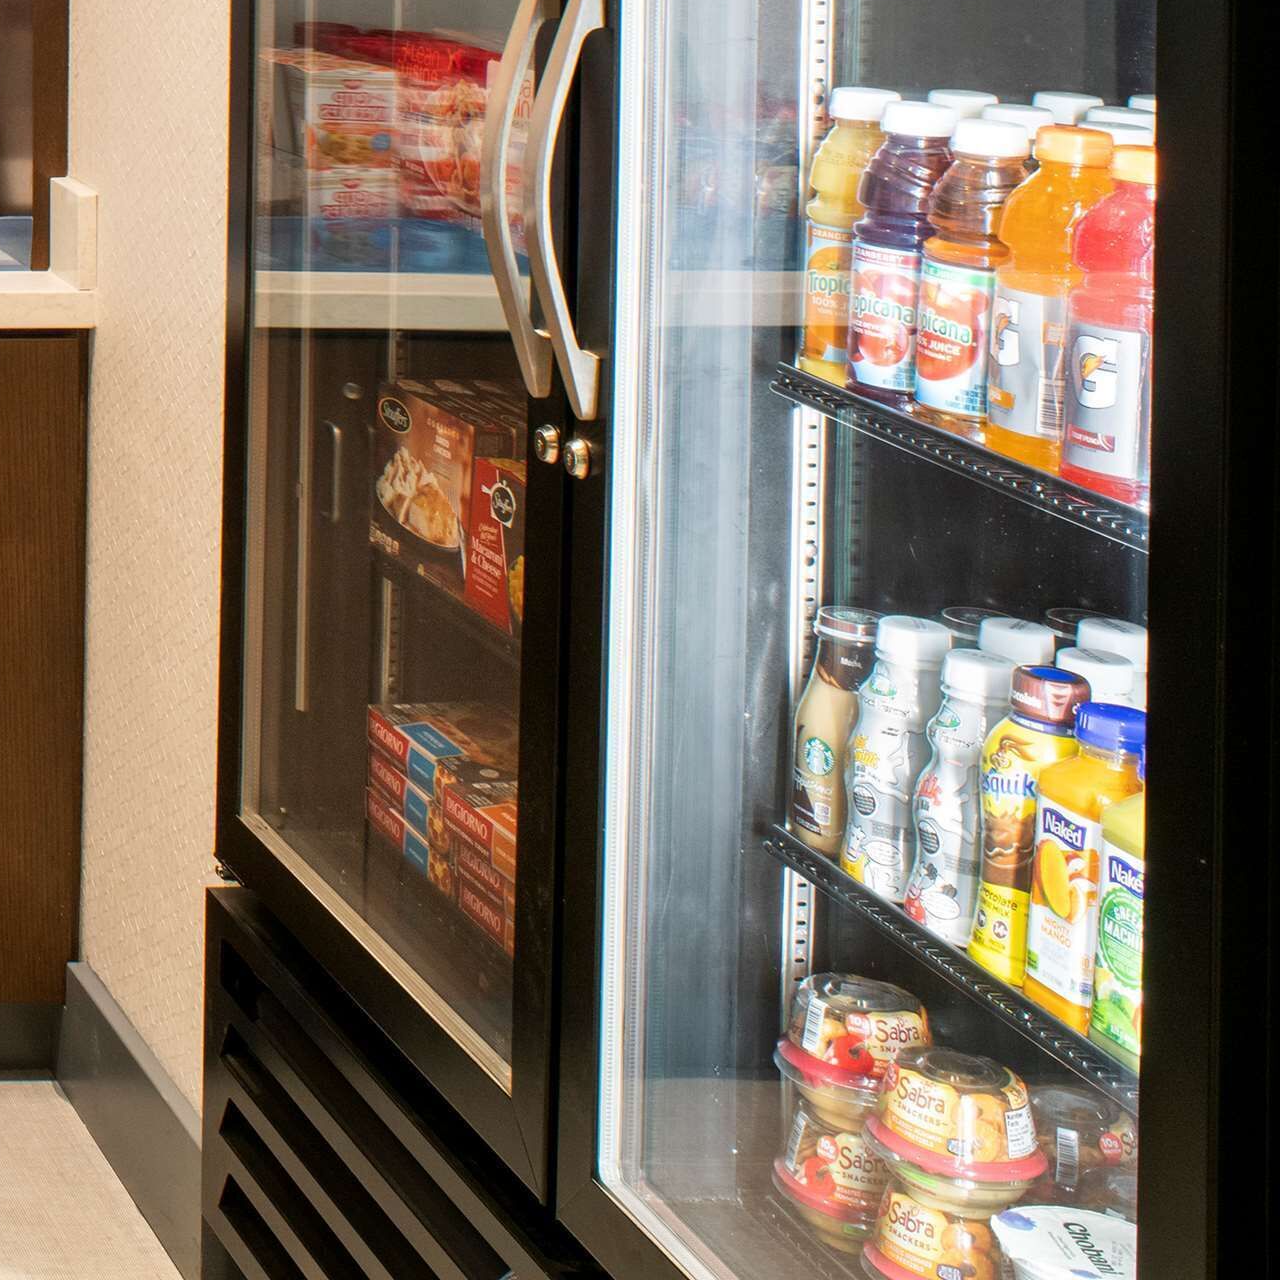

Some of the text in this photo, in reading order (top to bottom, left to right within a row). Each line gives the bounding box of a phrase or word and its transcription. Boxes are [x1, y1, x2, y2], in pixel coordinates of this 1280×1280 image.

[930, 340, 961, 356] JUICE
[471, 536, 503, 566] Macaroni
[478, 553, 503, 578] Cheese
[445, 798, 488, 839] DIGIORNO
[1044, 813, 1084, 849] Naked
[1042, 926, 1072, 949] MANGO
[875, 1019, 921, 1044] Sabra
[896, 1076, 945, 1114] Sabra
[899, 1101, 941, 1127] SNACKERS
[840, 1147, 890, 1174] Sabra
[889, 1202, 935, 1238] Sabra
[889, 1223, 932, 1251] SNACKERS
[1062, 1220, 1120, 1278] Chobani
